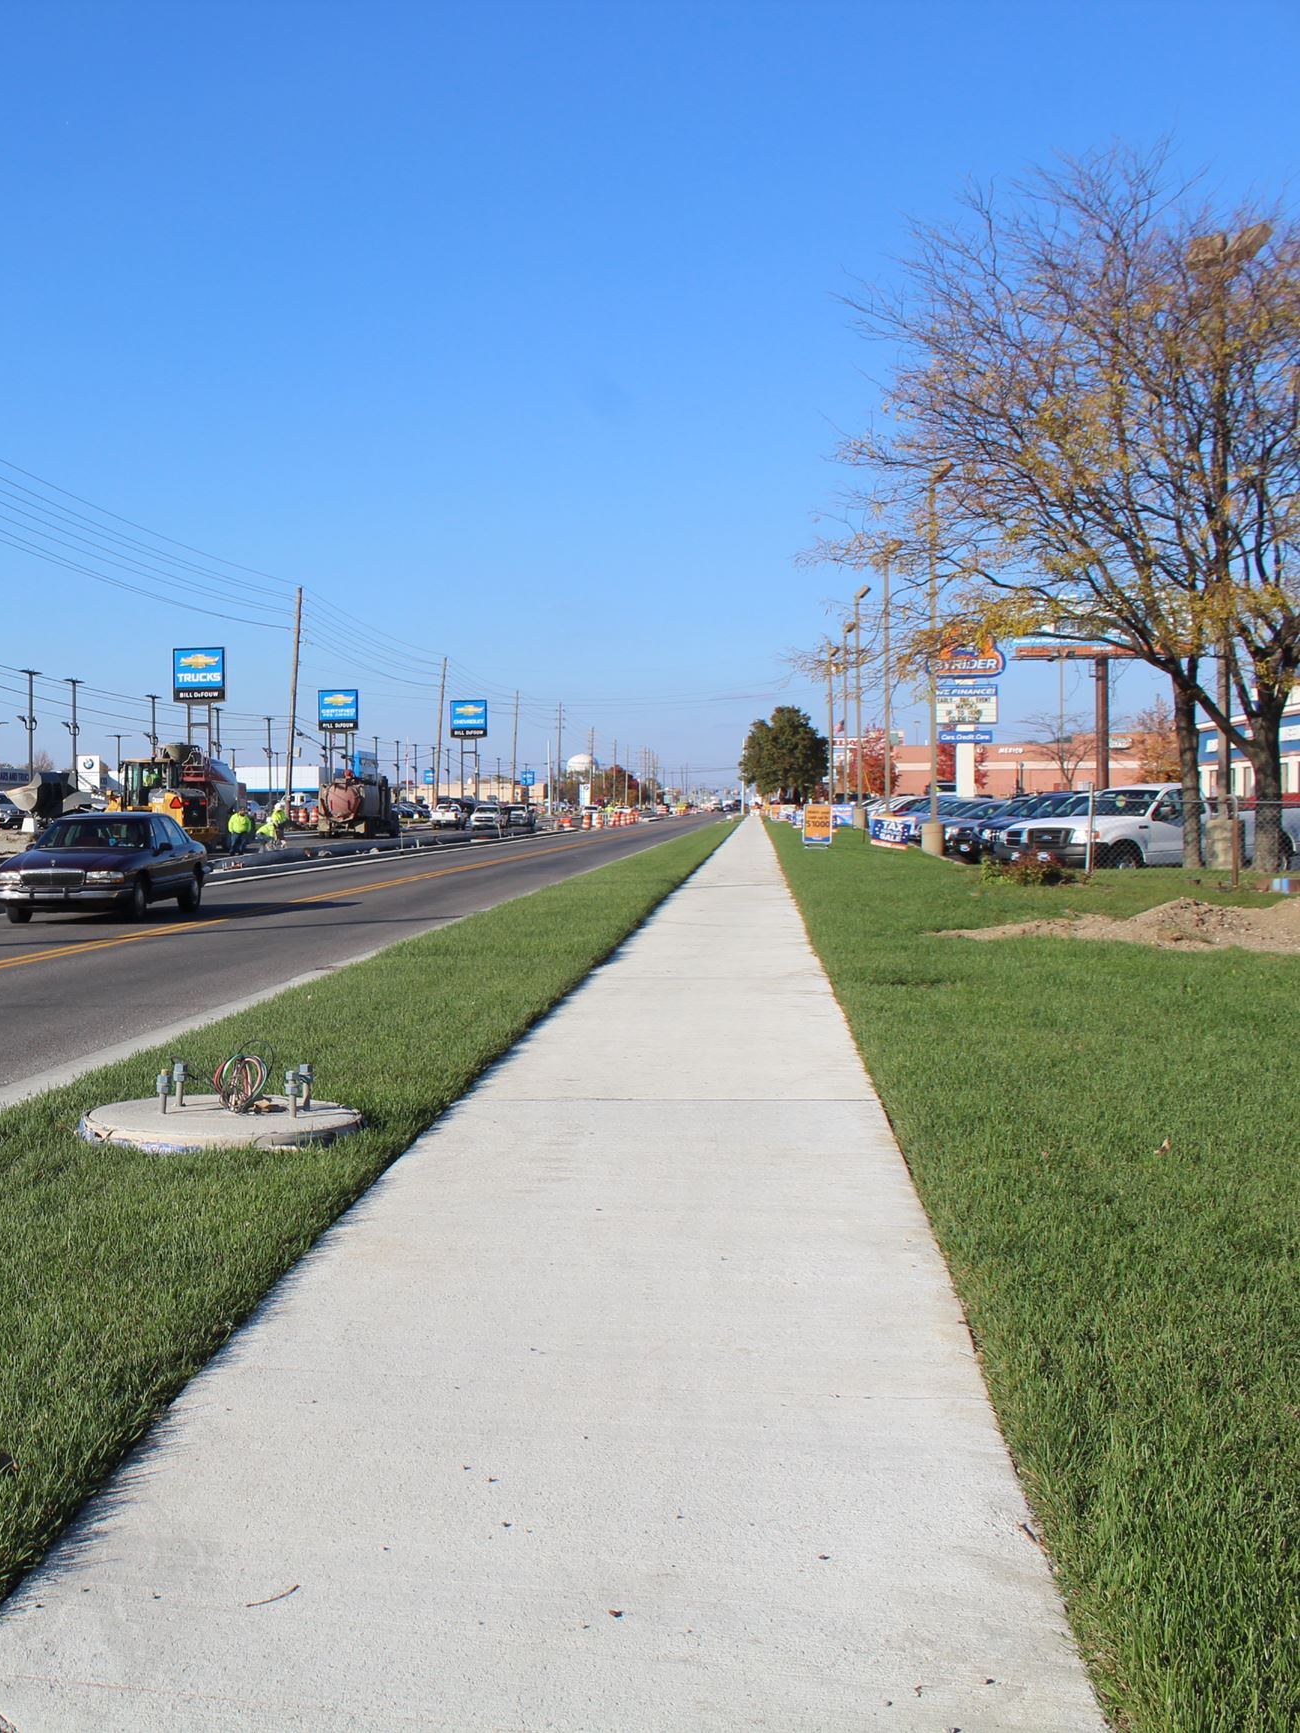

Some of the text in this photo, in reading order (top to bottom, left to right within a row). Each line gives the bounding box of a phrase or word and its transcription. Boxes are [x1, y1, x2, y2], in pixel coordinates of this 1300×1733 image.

[177, 672, 221, 682] TRUCKS
[951, 688, 996, 696] FINANCE!
[881, 820, 905, 833] TAX
[879, 833, 902, 842] SALE
